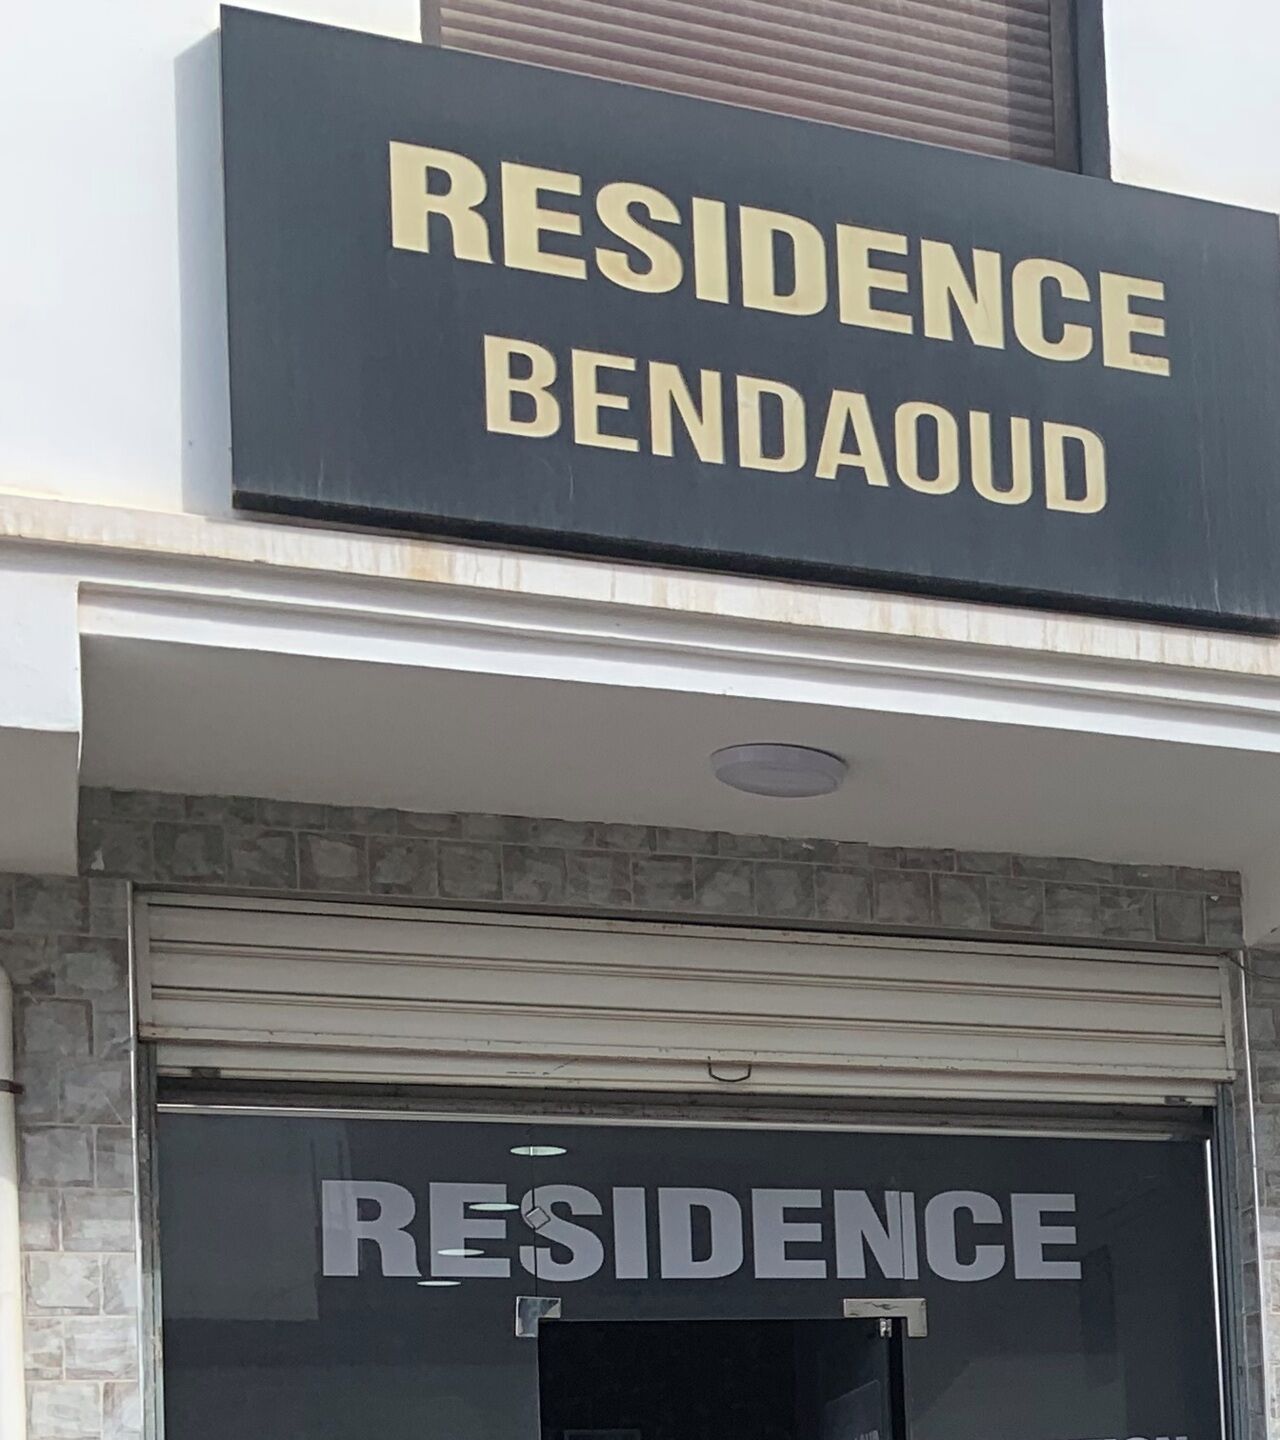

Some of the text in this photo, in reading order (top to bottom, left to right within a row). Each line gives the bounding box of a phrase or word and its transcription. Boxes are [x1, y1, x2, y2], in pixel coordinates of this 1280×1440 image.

[389, 139, 1172, 378] RESIDENCE
[484, 335, 1108, 516] BENDAOUD
[321, 1180, 1082, 1283] RESIDENCE
